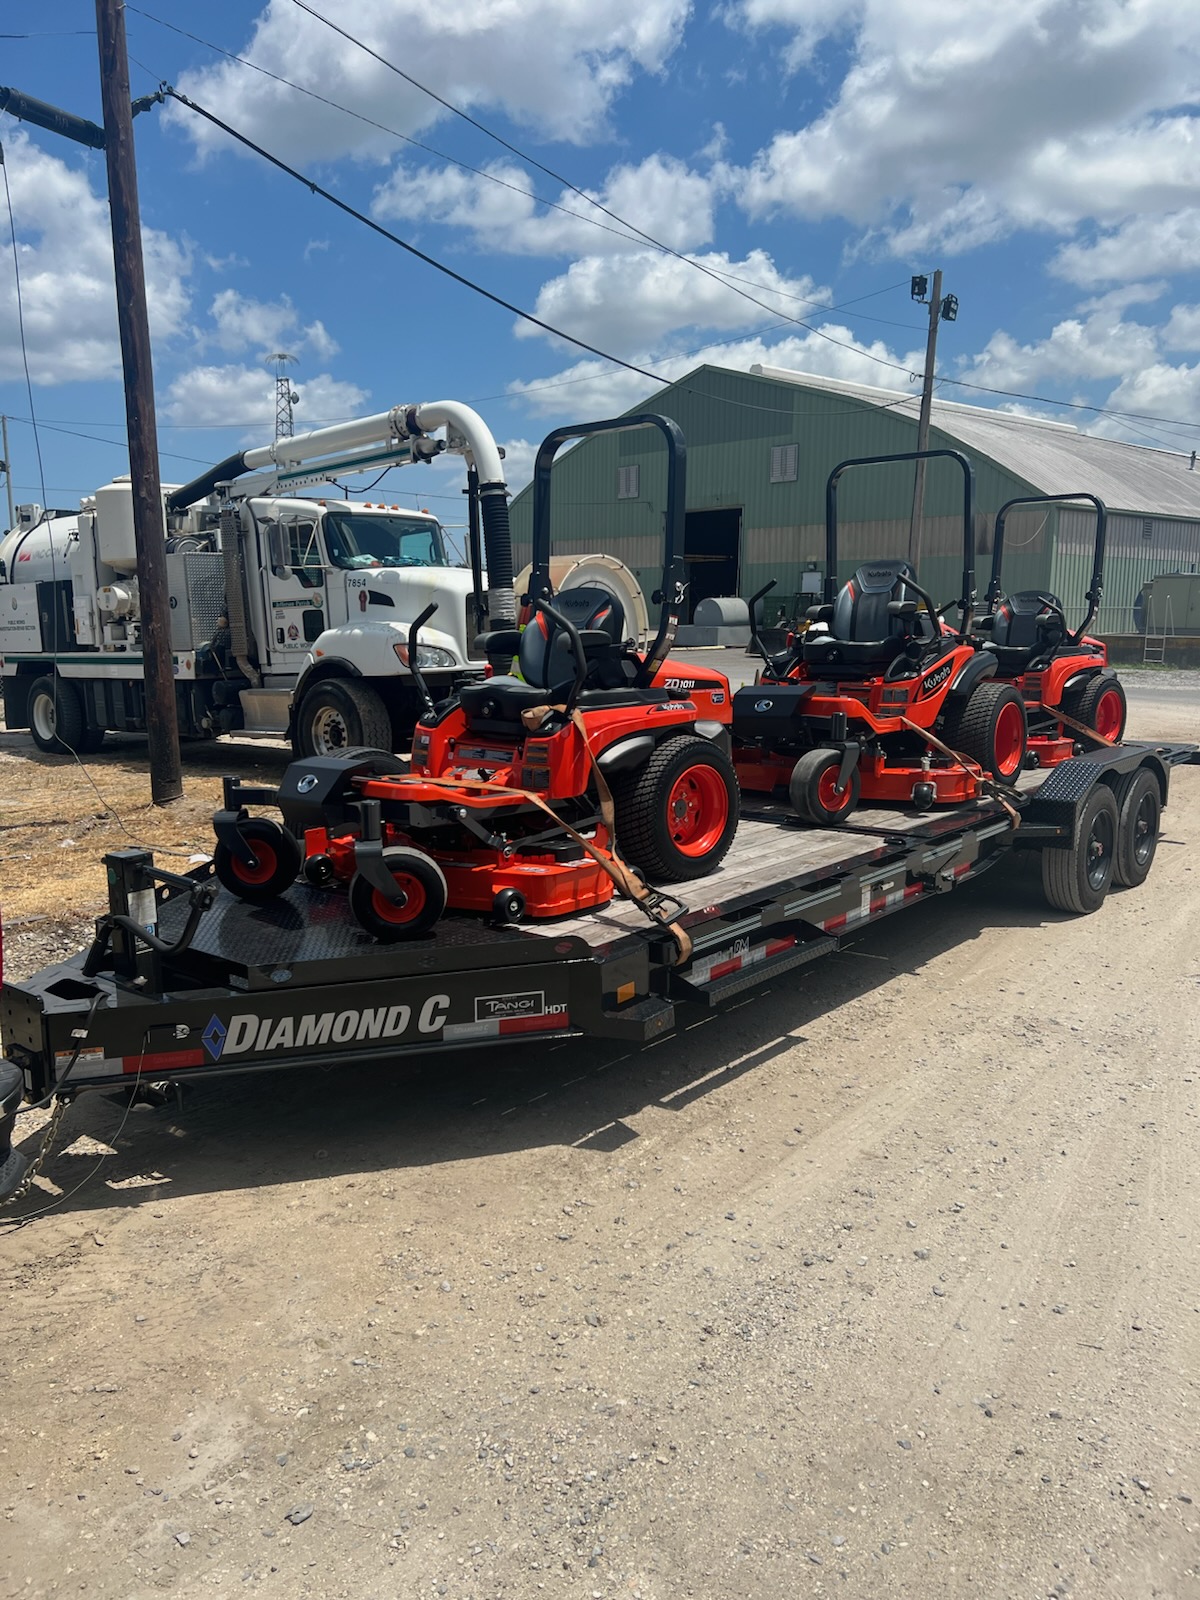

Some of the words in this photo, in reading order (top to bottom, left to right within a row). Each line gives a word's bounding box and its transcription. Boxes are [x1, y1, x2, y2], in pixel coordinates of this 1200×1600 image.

[347, 578, 366, 588] 7854
[565, 599, 590, 607] Kubota
[923, 666, 951, 689] Kubota
[485, 1000, 534, 1012] TANGI
[545, 1004, 567, 1014] HDT
[222, 1005, 411, 1055] DIAMOND
[418, 994, 451, 1034] C
